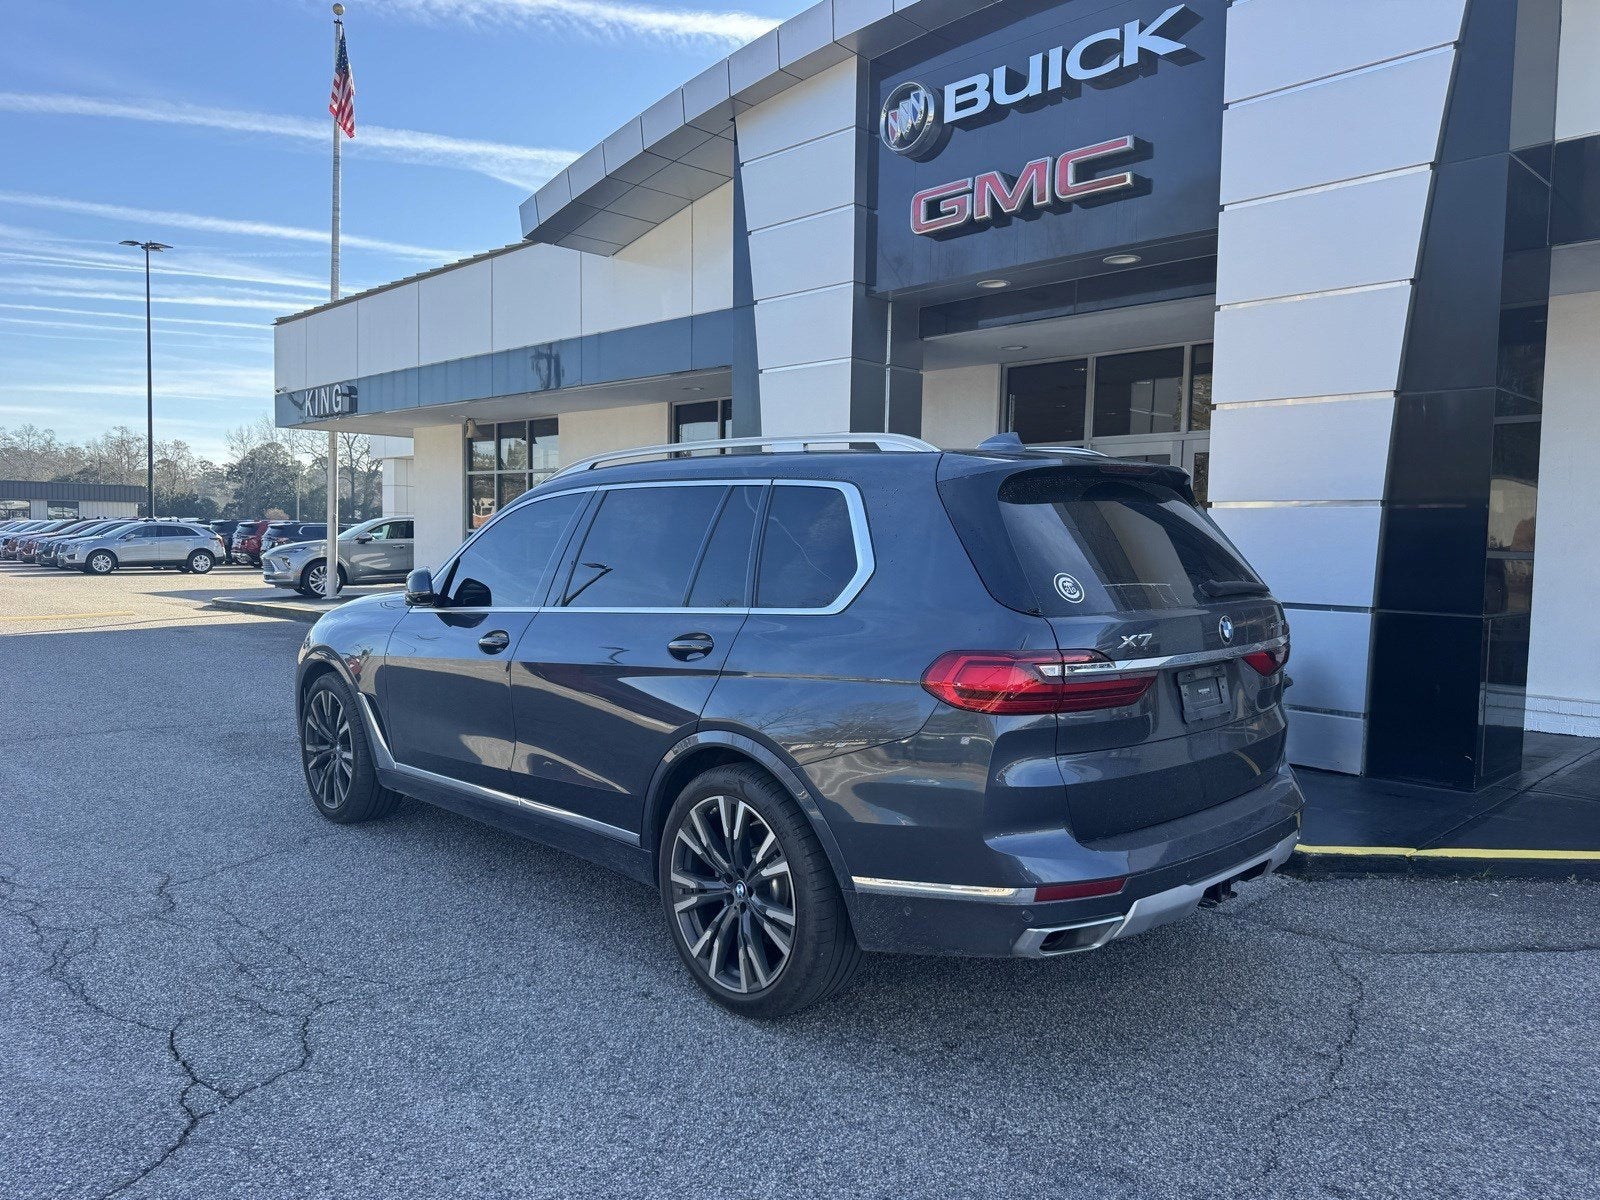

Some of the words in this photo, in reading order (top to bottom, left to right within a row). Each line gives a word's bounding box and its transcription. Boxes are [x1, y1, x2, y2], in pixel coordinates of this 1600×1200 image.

[944, 3, 1187, 124] BUICK
[911, 134, 1135, 235] GMC
[305, 384, 342, 416] KING
[1117, 633, 1153, 649] X7
